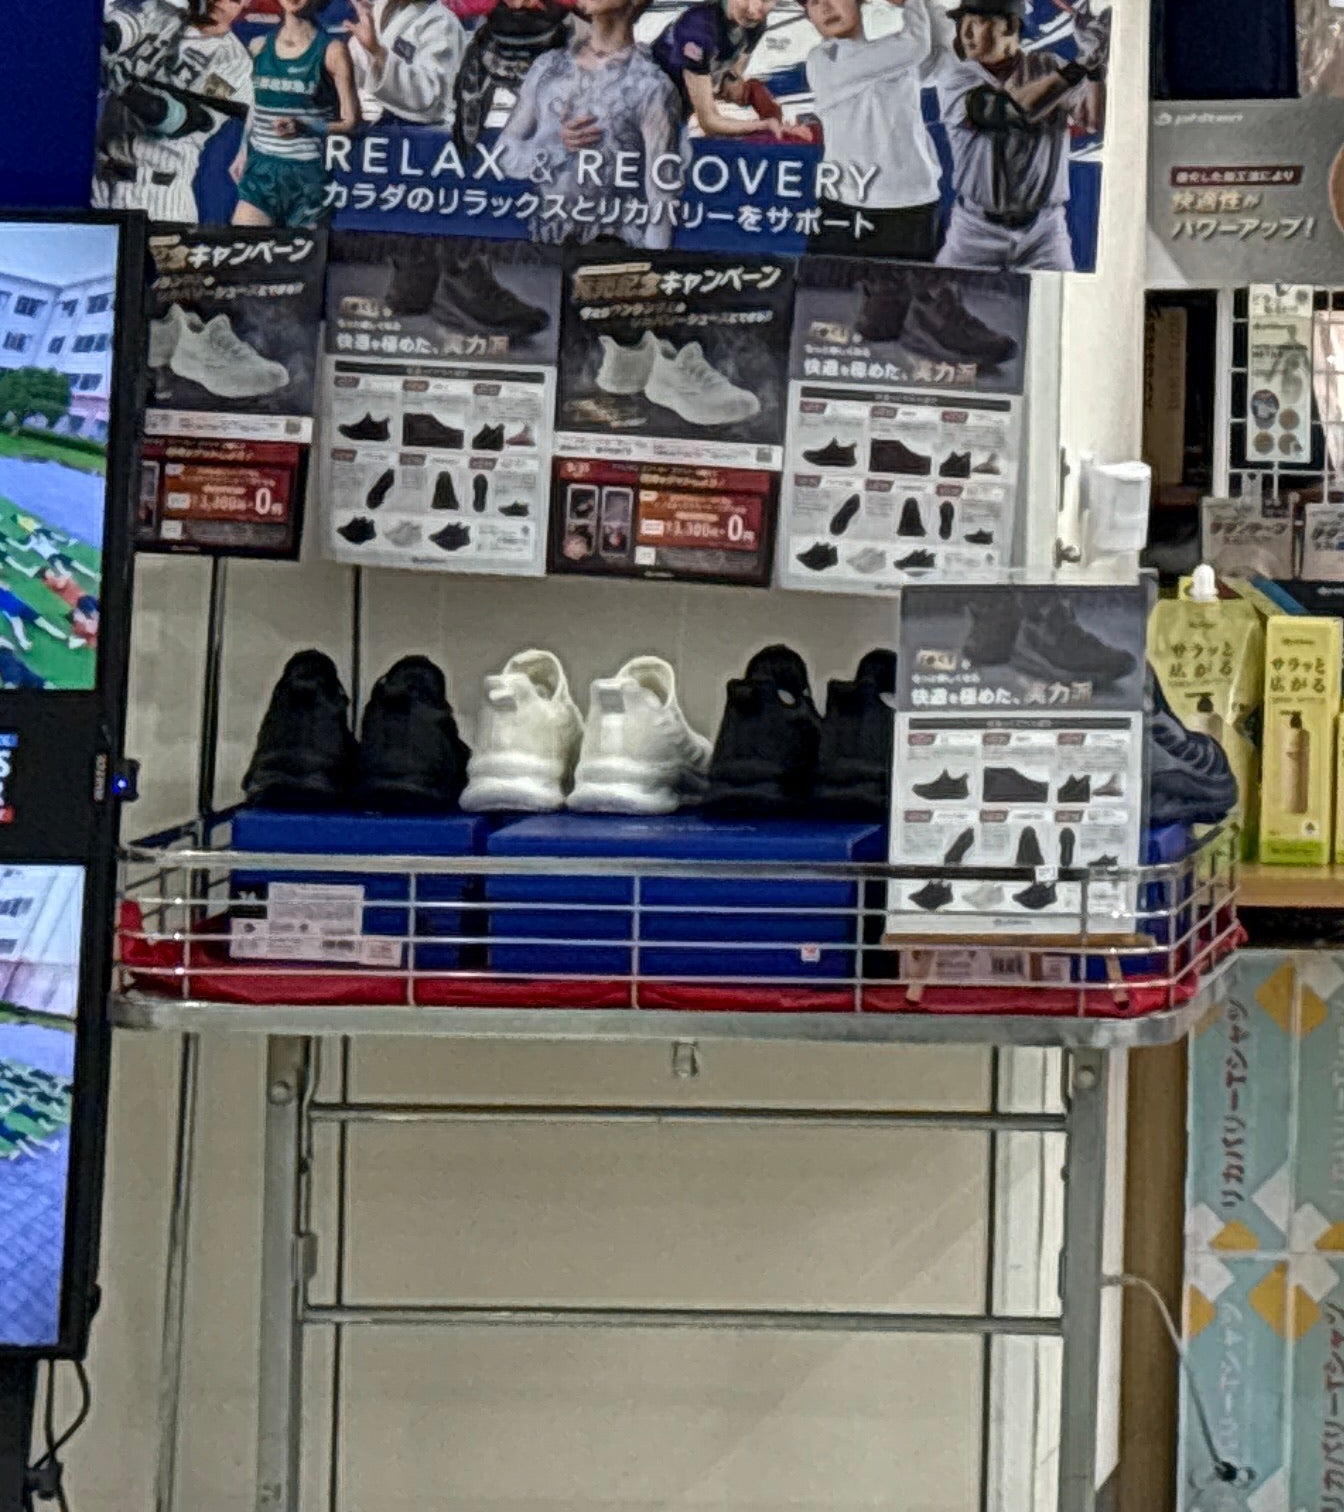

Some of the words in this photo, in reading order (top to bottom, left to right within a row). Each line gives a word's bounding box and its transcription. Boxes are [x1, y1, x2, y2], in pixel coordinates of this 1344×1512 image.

[325, 135, 507, 182] RELAX
[577, 151, 882, 202] RECOVERY
[322, 180, 876, 240] カラダのリラックスとリカバリーをサポート
